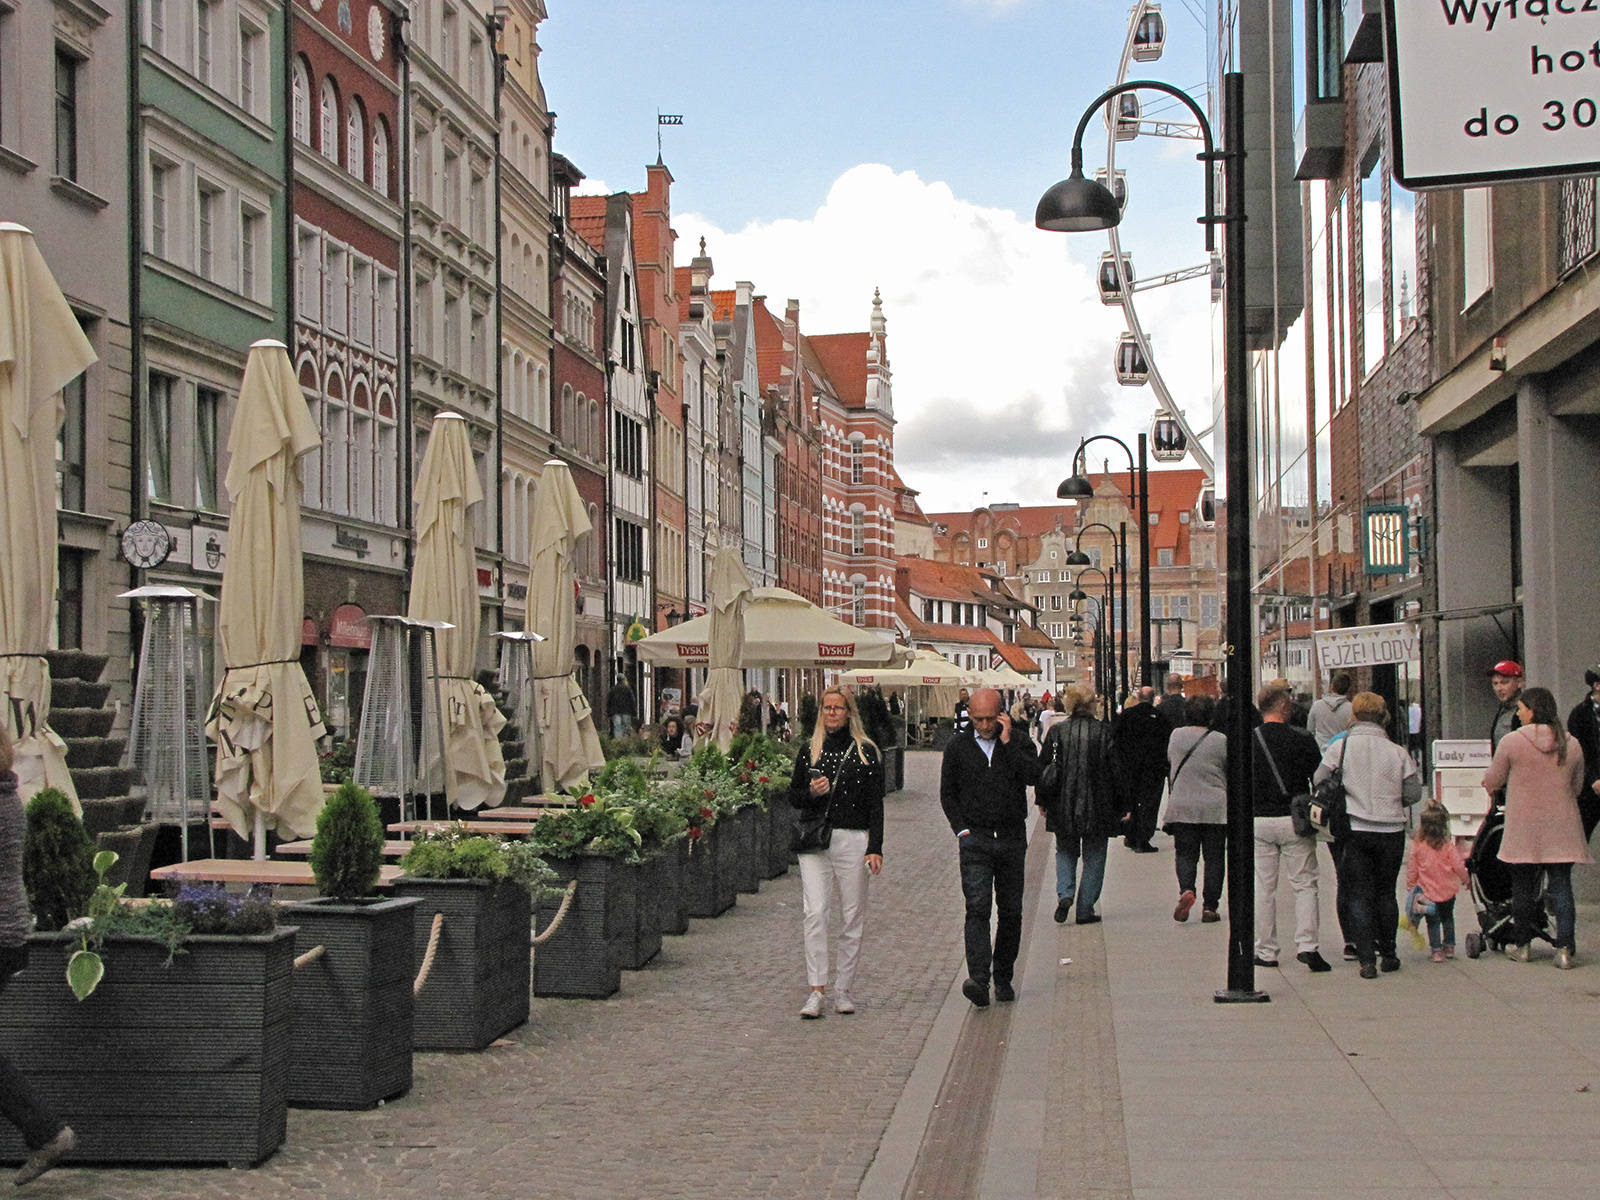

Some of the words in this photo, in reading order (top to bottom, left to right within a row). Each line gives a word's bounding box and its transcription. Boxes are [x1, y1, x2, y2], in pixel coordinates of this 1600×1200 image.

[1464, 107, 1519, 137] do
[1542, 98, 1597, 131] 30
[820, 645, 853, 655] TYSKIE
[1228, 644, 1235, 656] 2
[1372, 639, 1414, 662] LODY
[1438, 751, 1465, 762] Lody
